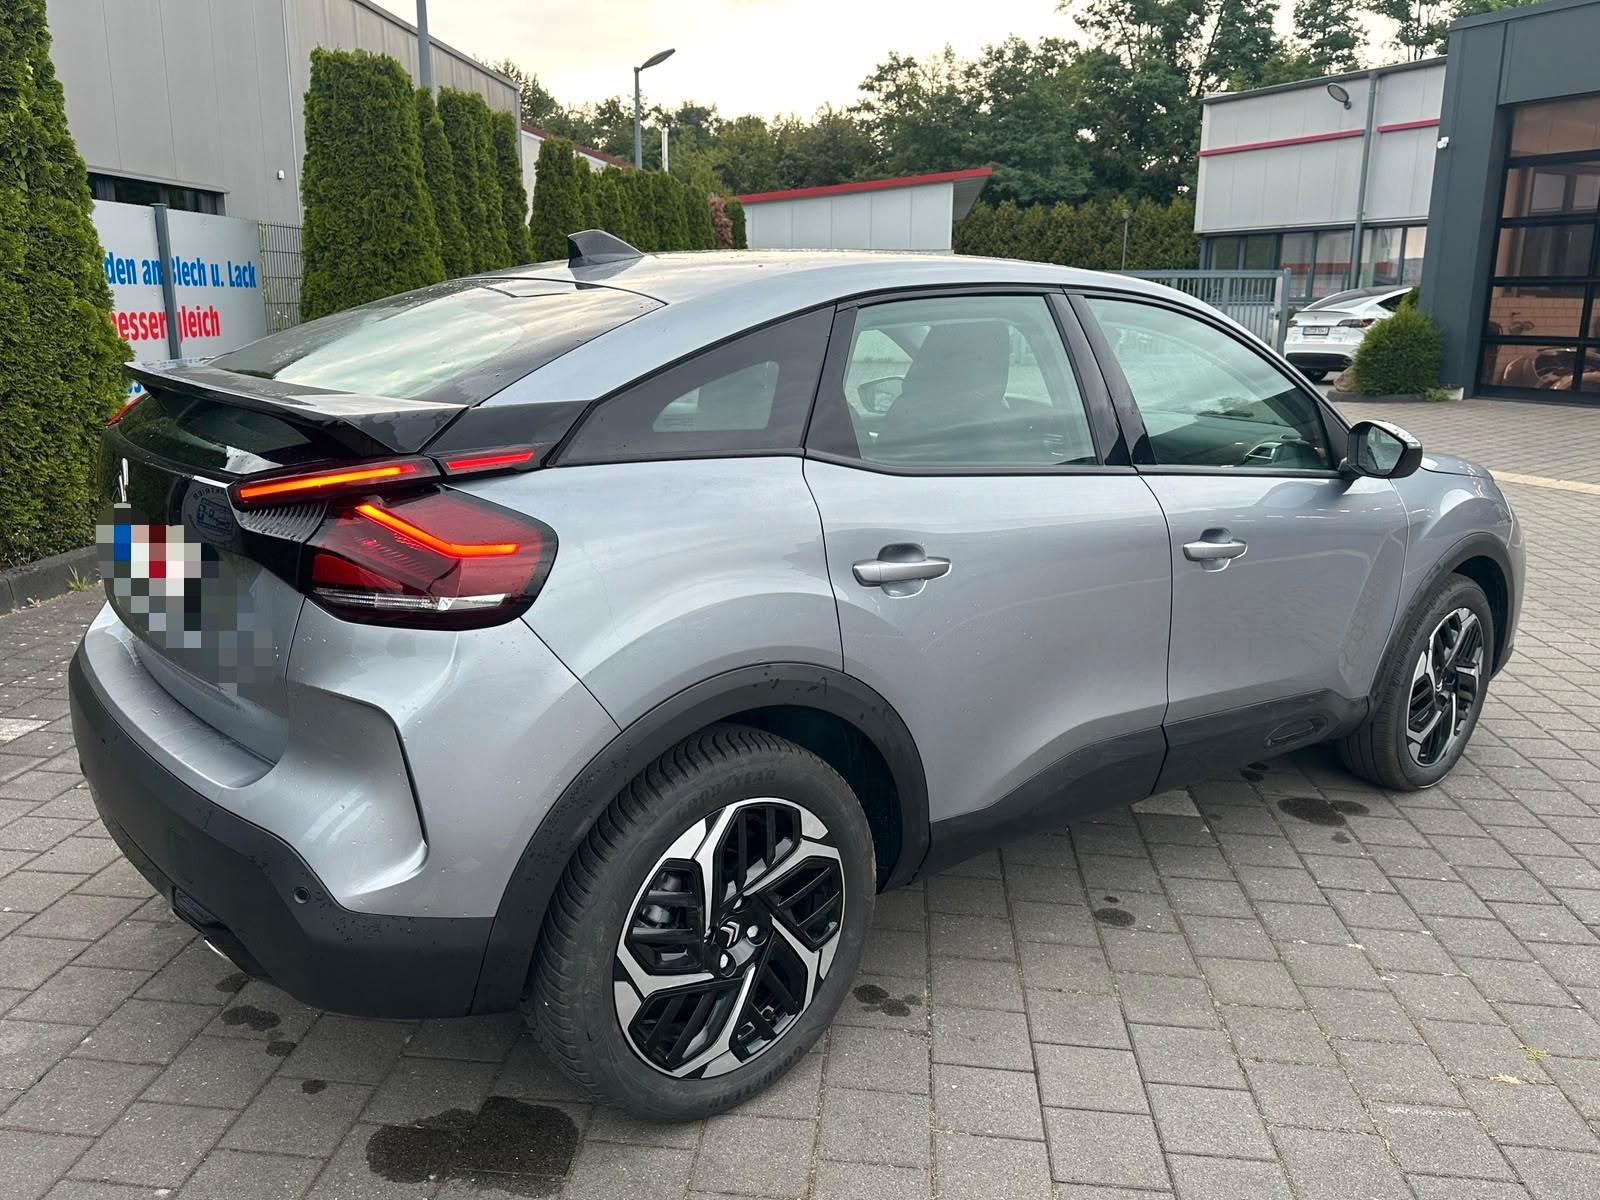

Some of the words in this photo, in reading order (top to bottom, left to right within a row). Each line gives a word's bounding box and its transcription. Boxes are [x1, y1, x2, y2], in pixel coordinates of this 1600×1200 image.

[102, 251, 137, 285] den
[211, 263, 225, 288] u.
[227, 260, 257, 289] Lack
